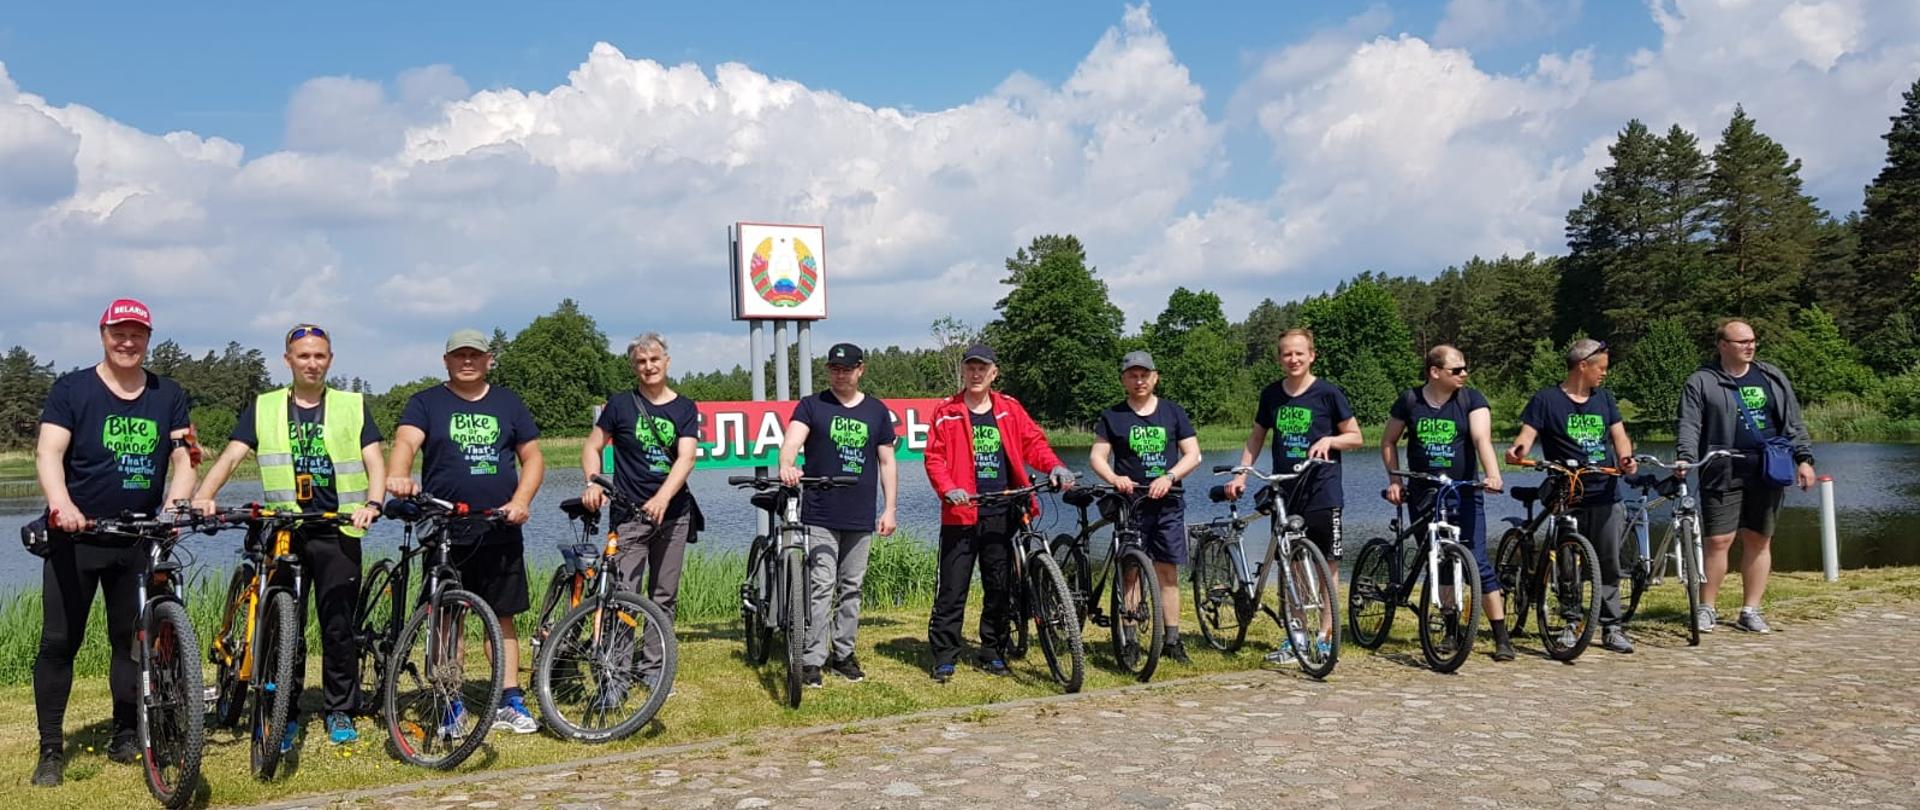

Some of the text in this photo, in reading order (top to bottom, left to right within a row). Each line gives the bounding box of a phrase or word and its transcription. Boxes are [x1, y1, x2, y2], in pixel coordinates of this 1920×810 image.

[114, 305, 149, 318] BELARUS
[1280, 405, 1305, 421] Bike
[109, 416, 149, 437] Bike
[454, 414, 491, 430] Bike
[835, 416, 862, 434] Bike
[1420, 418, 1450, 433] Bike
[1571, 413, 1598, 429] Bike
[453, 430, 499, 444] canoe?
[832, 432, 868, 447] canoe?
[1132, 426, 1160, 441] Bike
[106, 438, 157, 454] canoe?
[467, 444, 496, 455] That's
[121, 454, 153, 466] That's
